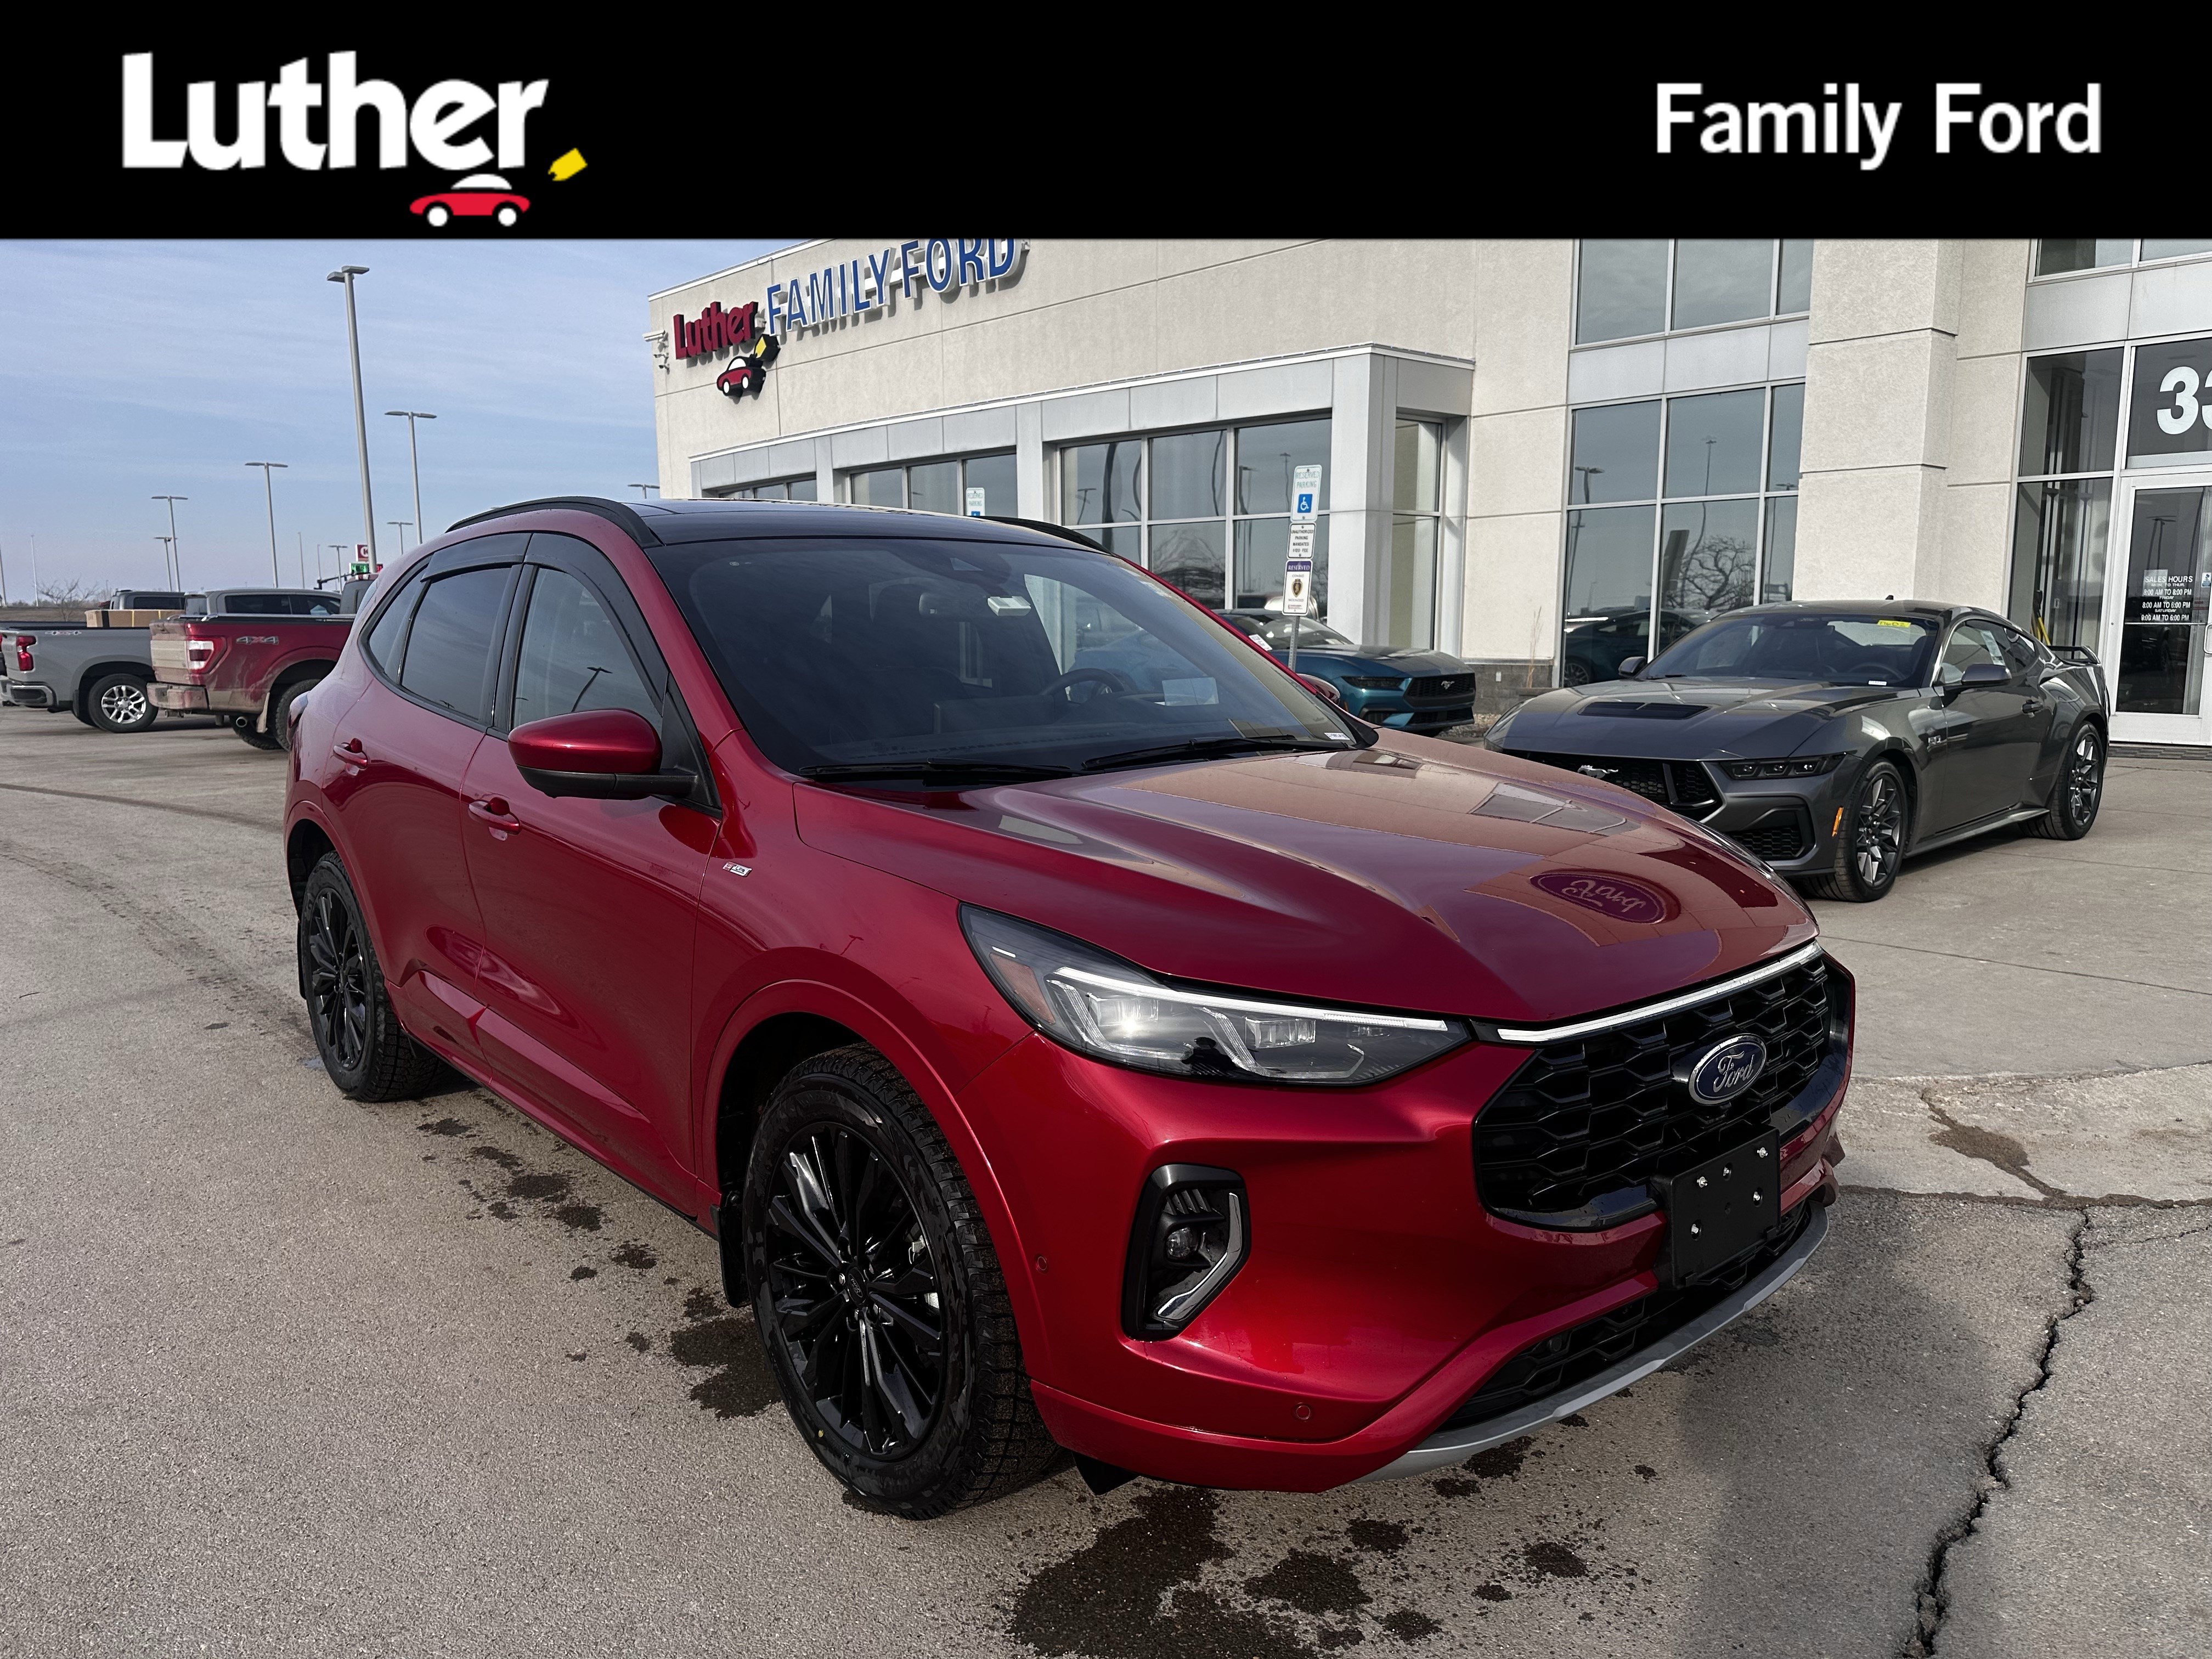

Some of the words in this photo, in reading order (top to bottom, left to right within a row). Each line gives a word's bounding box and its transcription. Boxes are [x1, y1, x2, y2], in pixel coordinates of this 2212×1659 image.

[766, 247, 894, 337] FAMILY
[900, 238, 1018, 300] FORD
[673, 301, 758, 360] Luther
[2157, 366, 2212, 435] 3
[1712, 1049, 1756, 1093] Ford
